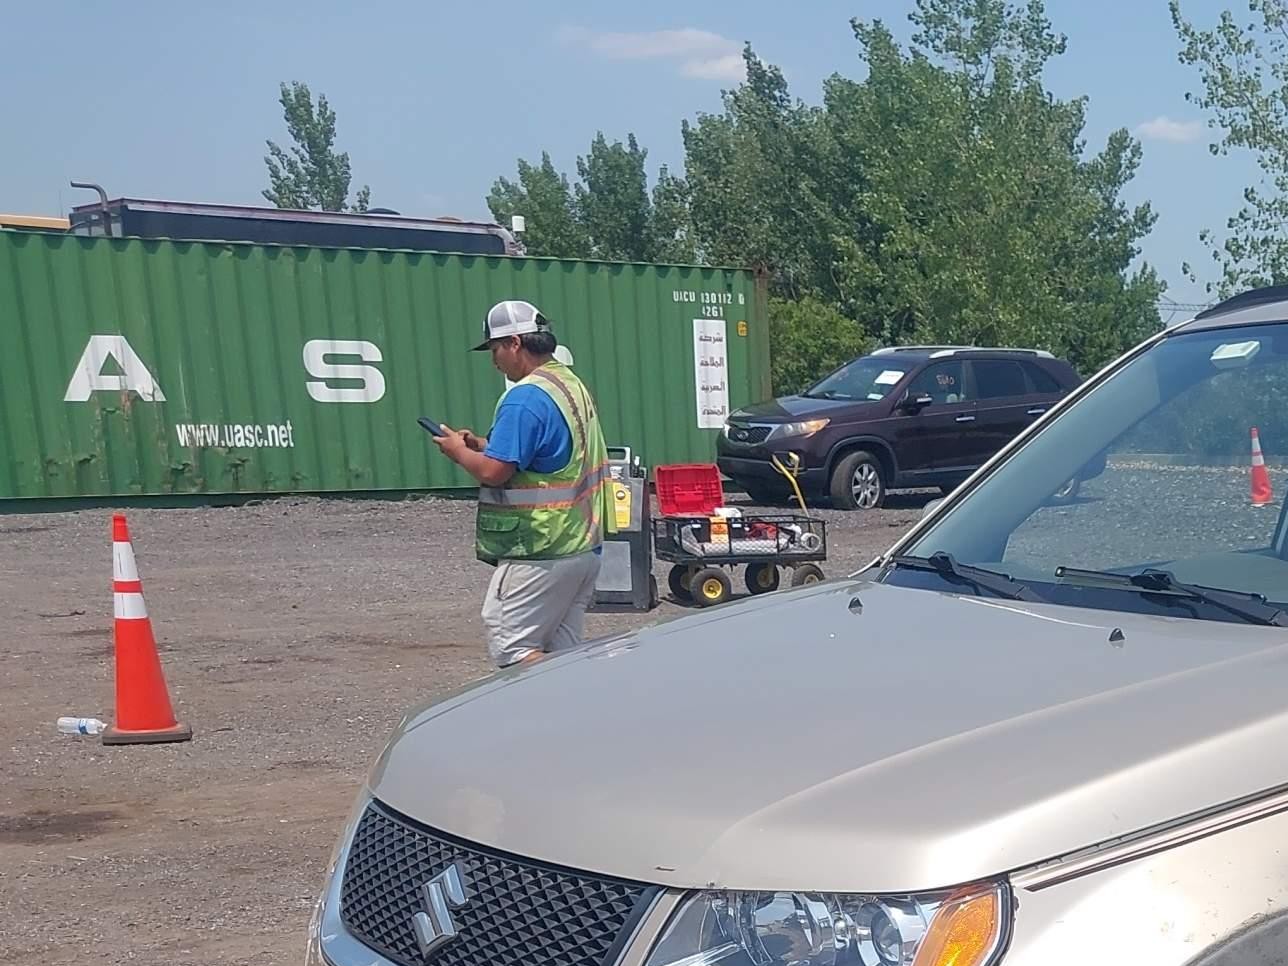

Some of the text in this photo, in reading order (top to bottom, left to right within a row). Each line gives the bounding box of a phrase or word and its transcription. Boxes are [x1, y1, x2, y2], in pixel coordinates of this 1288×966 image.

[64, 335, 386, 402] A S
[176, 419, 295, 449] www.uasc.net
